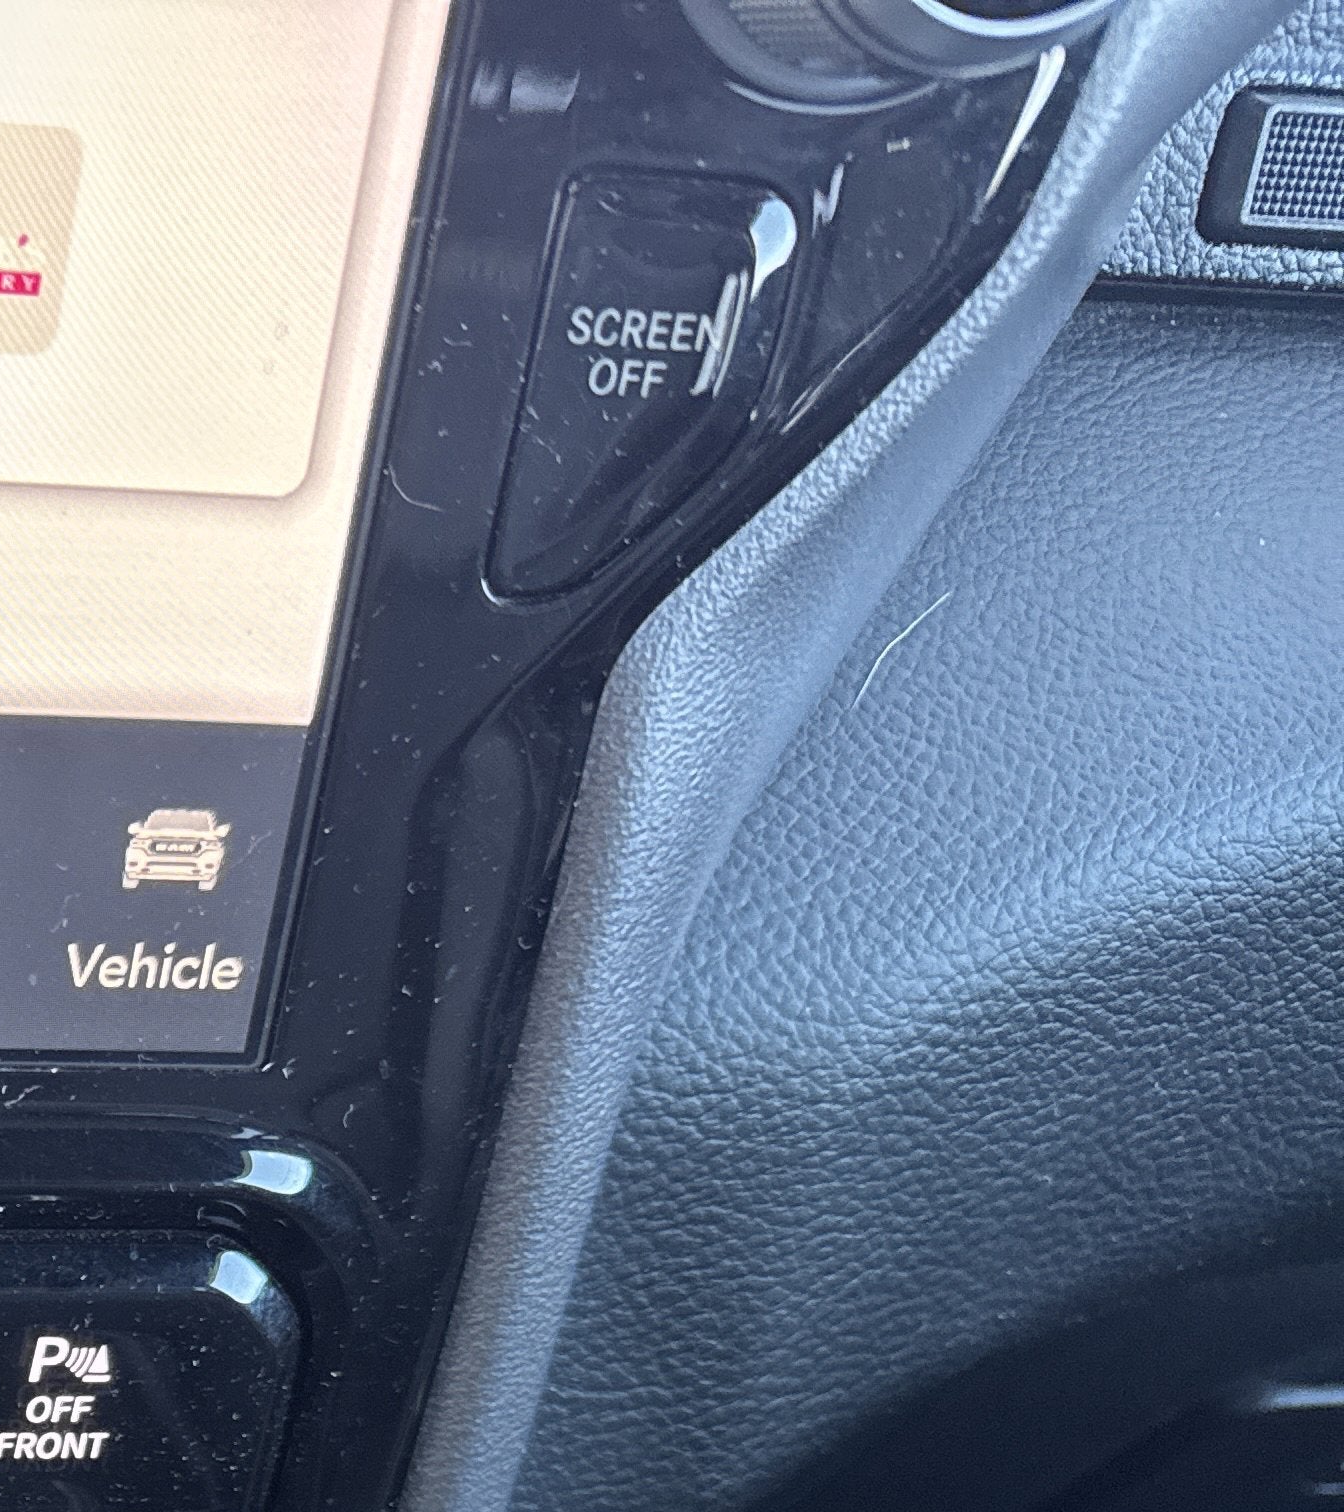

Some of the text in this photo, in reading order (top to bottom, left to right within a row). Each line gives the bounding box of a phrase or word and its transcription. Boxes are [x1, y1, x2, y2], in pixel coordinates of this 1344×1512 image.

[567, 305, 723, 353] SCREEN
[588, 357, 668, 398] OFF
[67, 942, 243, 991] Vehicle
[25, 1396, 95, 1423] OFF
